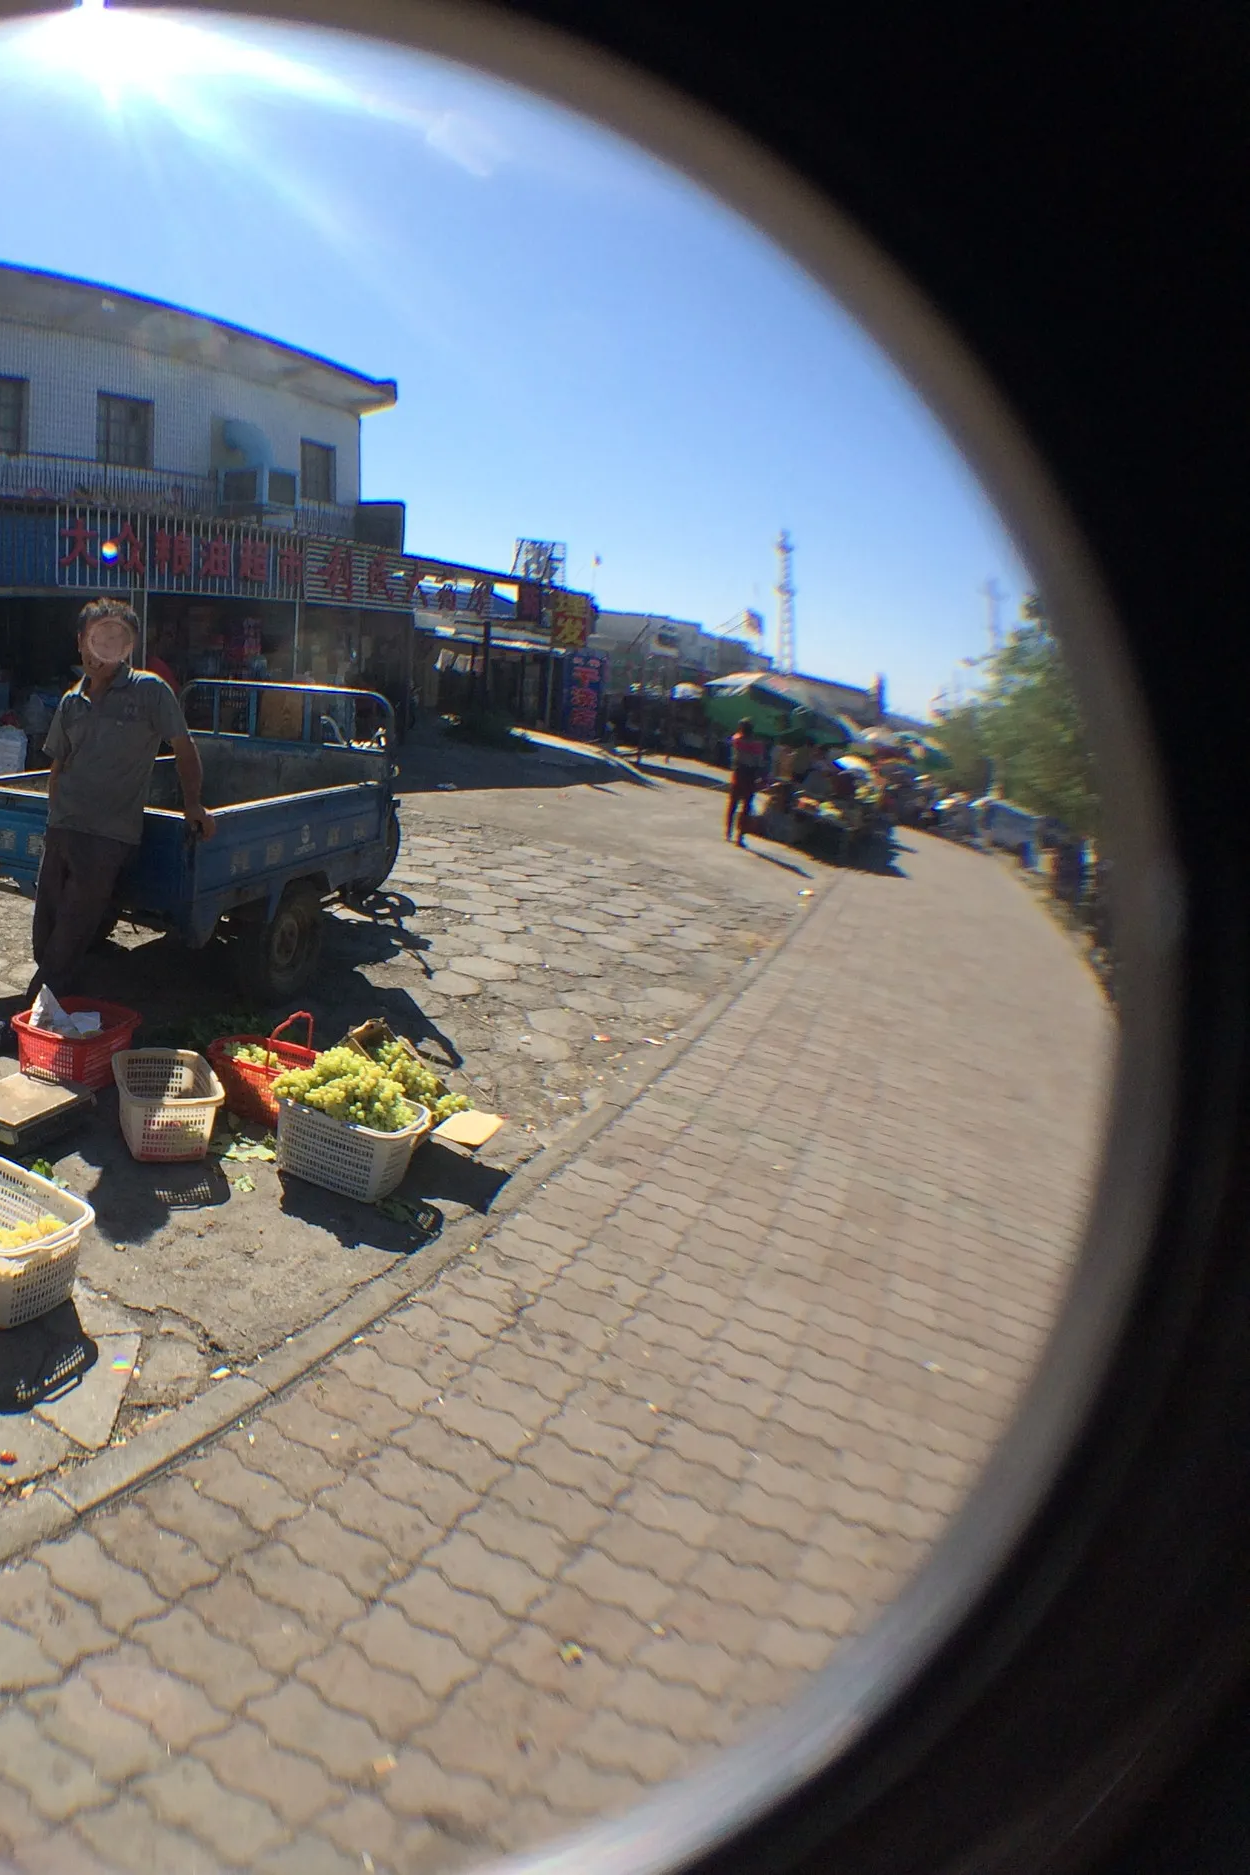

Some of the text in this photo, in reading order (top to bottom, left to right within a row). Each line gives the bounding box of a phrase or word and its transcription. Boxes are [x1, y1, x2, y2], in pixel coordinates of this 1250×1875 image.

[60, 517, 304, 585] 大众粮油超市
